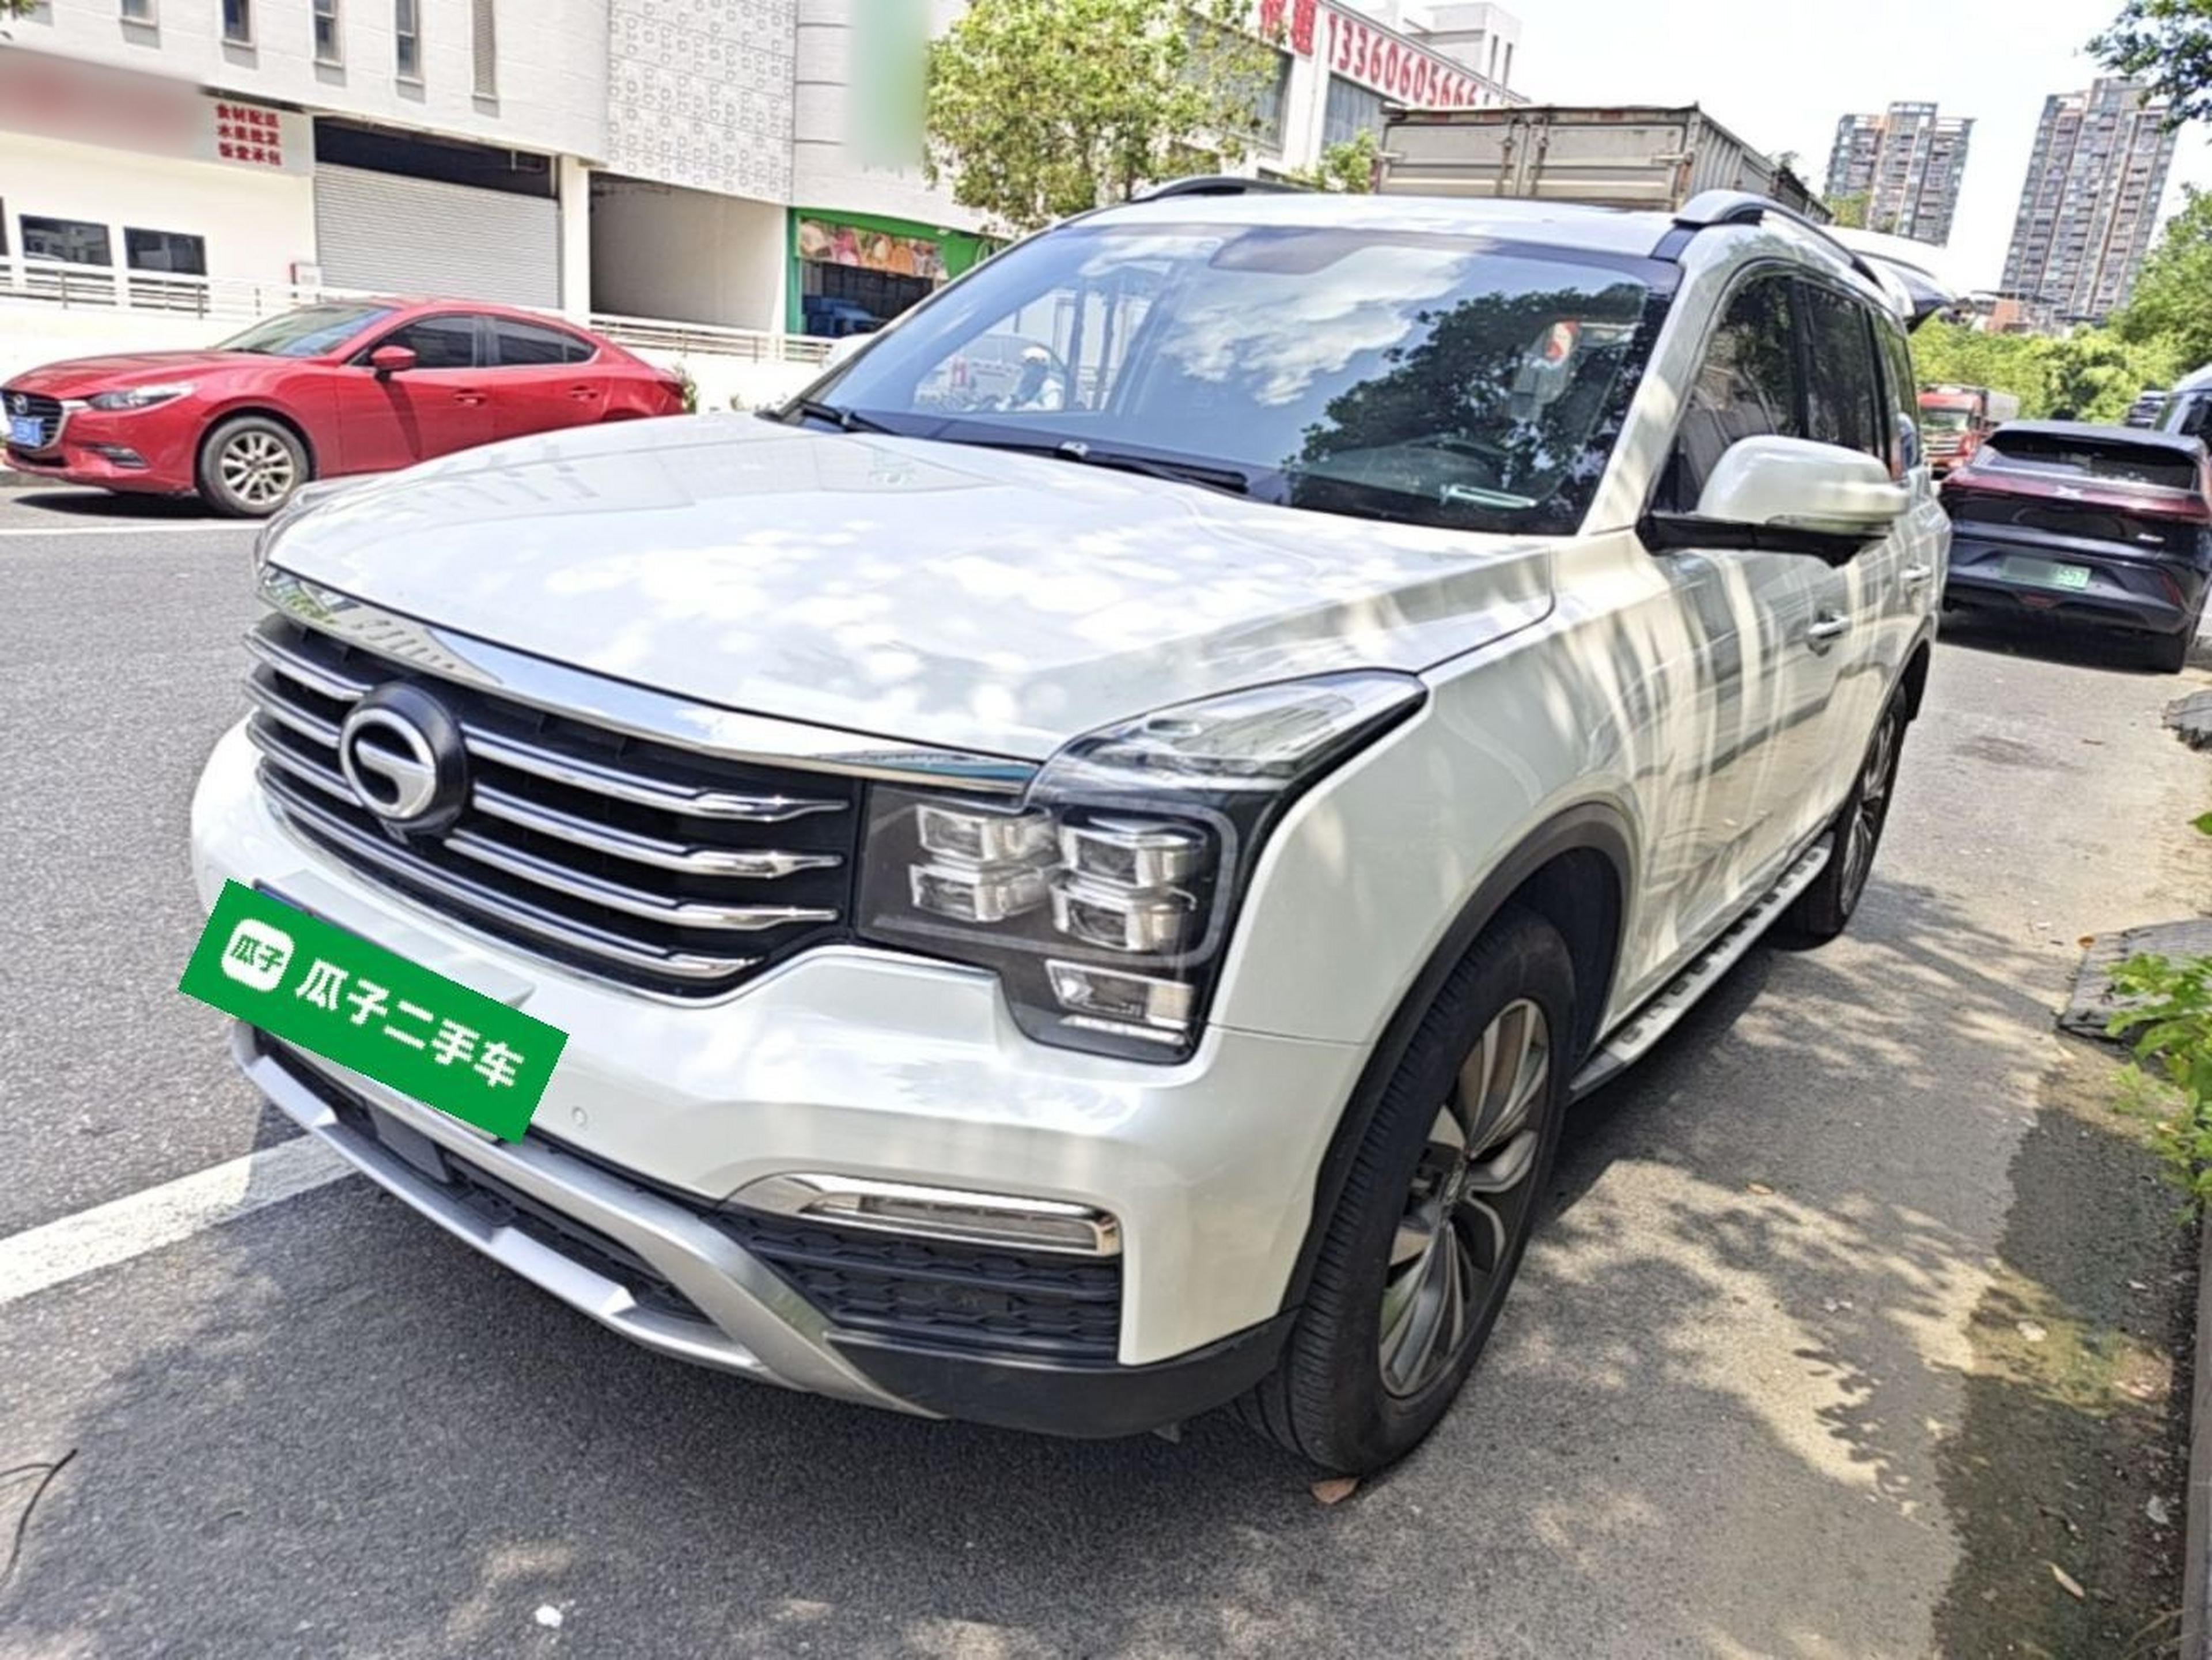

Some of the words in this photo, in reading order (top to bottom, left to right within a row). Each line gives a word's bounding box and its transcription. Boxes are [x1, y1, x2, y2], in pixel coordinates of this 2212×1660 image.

[217, 103, 279, 128] 食材配送
[217, 123, 281, 147] 水果批发
[218, 142, 282, 165] 饭堂承包
